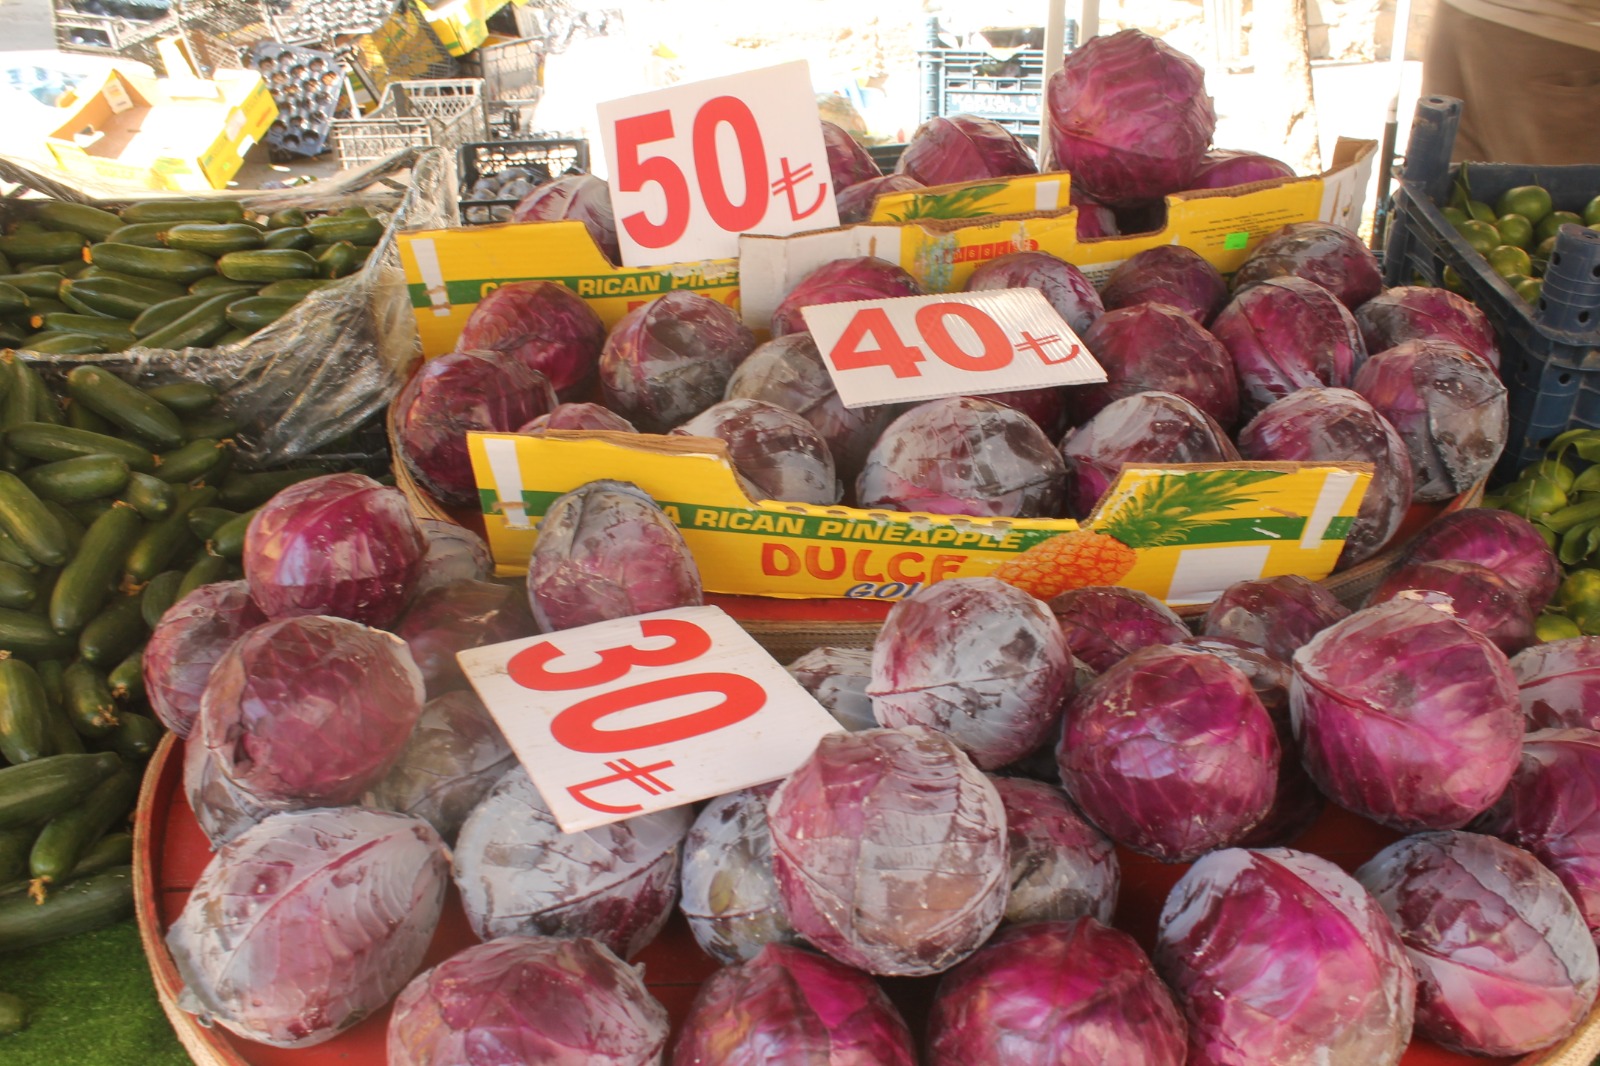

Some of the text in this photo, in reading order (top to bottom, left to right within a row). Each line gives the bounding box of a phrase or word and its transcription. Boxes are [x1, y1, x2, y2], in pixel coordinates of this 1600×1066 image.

[577, 275, 661, 297] RICAN
[694, 508, 806, 535] RICAN
[817, 520, 1025, 550] PINEAPPLE
[761, 542, 969, 585] DULCE
